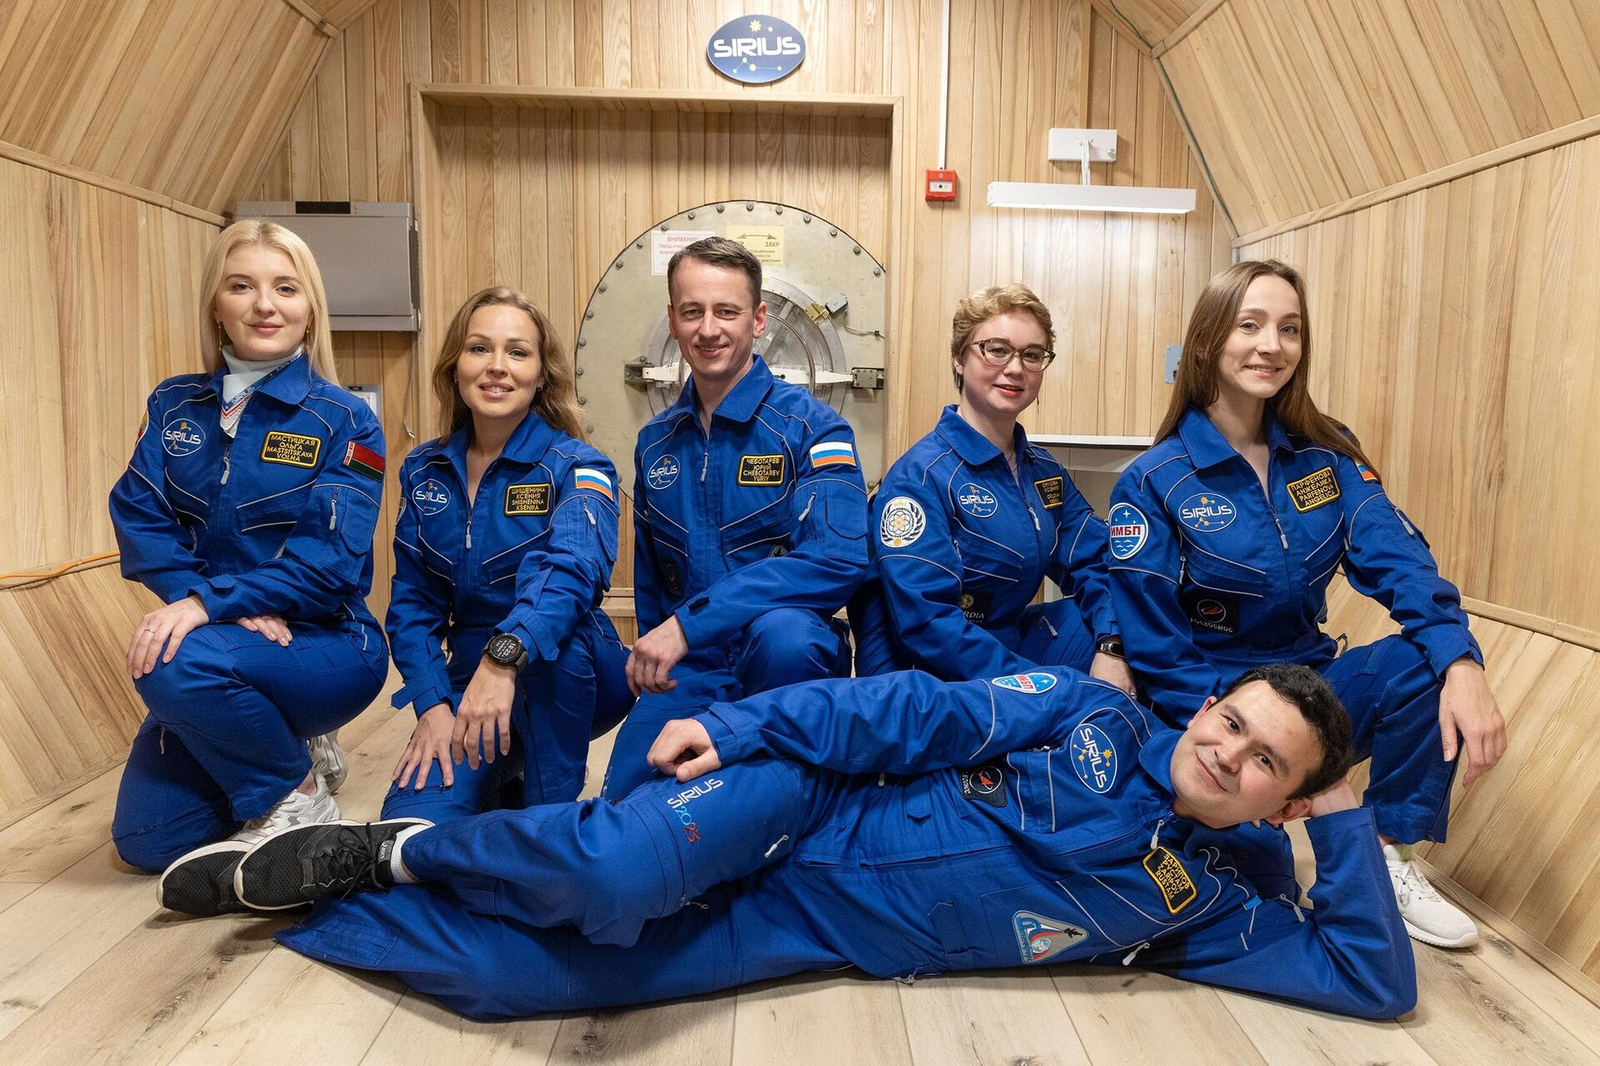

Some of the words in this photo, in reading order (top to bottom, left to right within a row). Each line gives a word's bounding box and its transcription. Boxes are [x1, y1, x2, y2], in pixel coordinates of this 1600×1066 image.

[713, 36, 801, 58] SIRIUS
[164, 430, 202, 445] SIRIUS
[270, 434, 316, 446] МАСТИЦКАЯ
[266, 446, 314, 459] MASTSITSKAYA
[279, 441, 303, 451] ОЛЬГА
[276, 452, 301, 462] VOLHA
[746, 457, 780, 466] ЧЕБОТАРЕВ
[742, 469, 780, 477] CHEBOTAREV
[753, 463, 772, 471] ЮРИЙ
[1290, 470, 1331, 491] ПАРФЕНОВА
[1296, 477, 1332, 497] АНЖЕЛИКА
[960, 494, 994, 505] SIRIUS
[1299, 484, 1334, 502] PARFENOVA
[1305, 489, 1336, 507] ANGELICA
[1182, 505, 1232, 519] SIRIUS
[1110, 525, 1142, 537] ИМБП
[963, 610, 985, 619] RDIA
[1079, 727, 1107, 788] SIRIUS
[667, 778, 724, 809] SIRIUS
[1157, 863, 1180, 895] ZARIPOV
[1162, 859, 1185, 892] РУСТАМ
[1163, 853, 1190, 890] ЗАРИПОВ
[1154, 869, 1175, 900] RUSTAM
